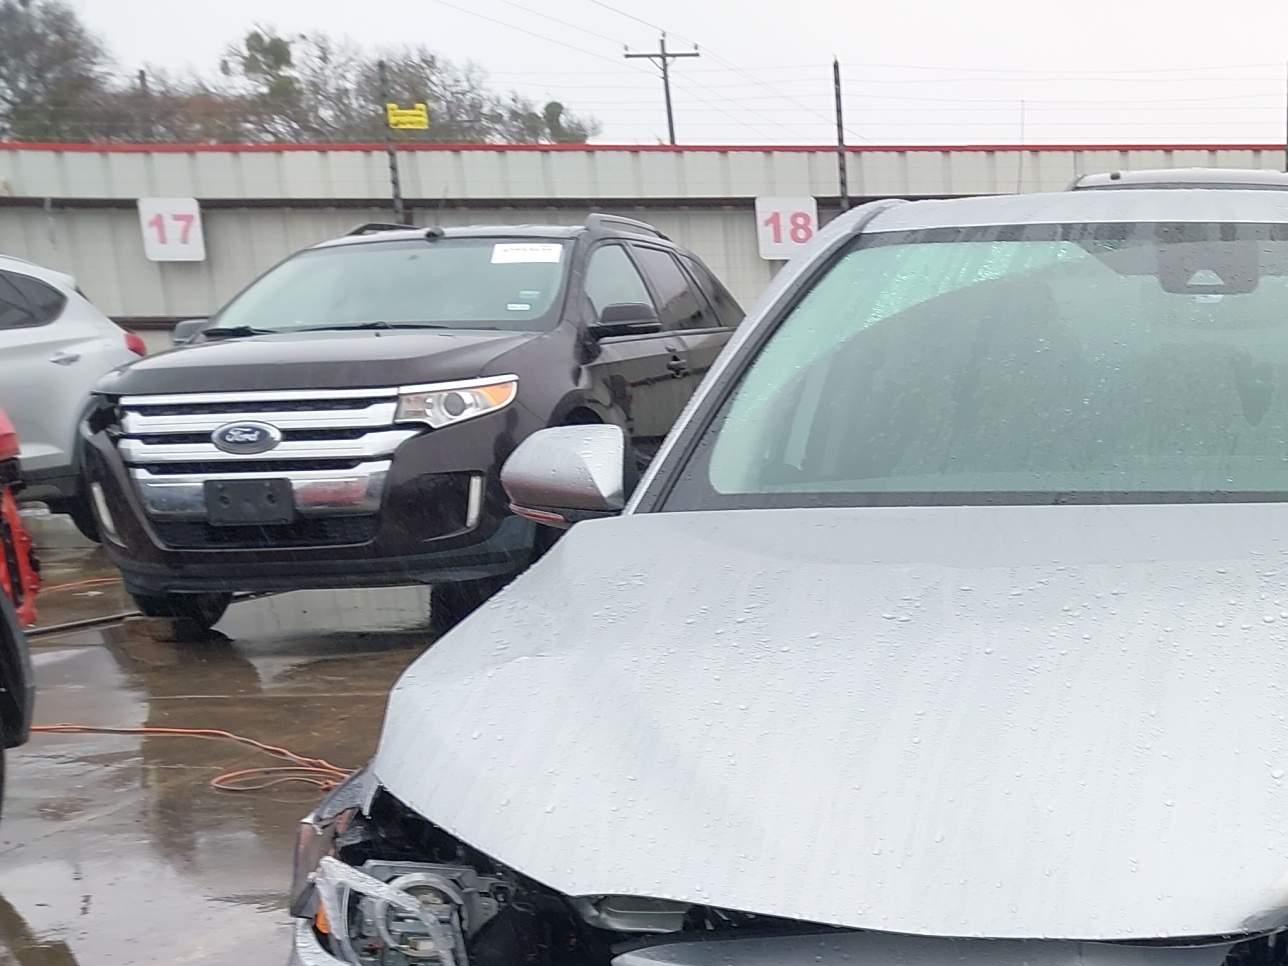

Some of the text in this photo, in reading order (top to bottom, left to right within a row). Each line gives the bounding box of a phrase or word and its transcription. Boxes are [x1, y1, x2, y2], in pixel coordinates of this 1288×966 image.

[147, 213, 195, 246] 17
[764, 211, 813, 244] 18
[225, 427, 260, 443] Ford
